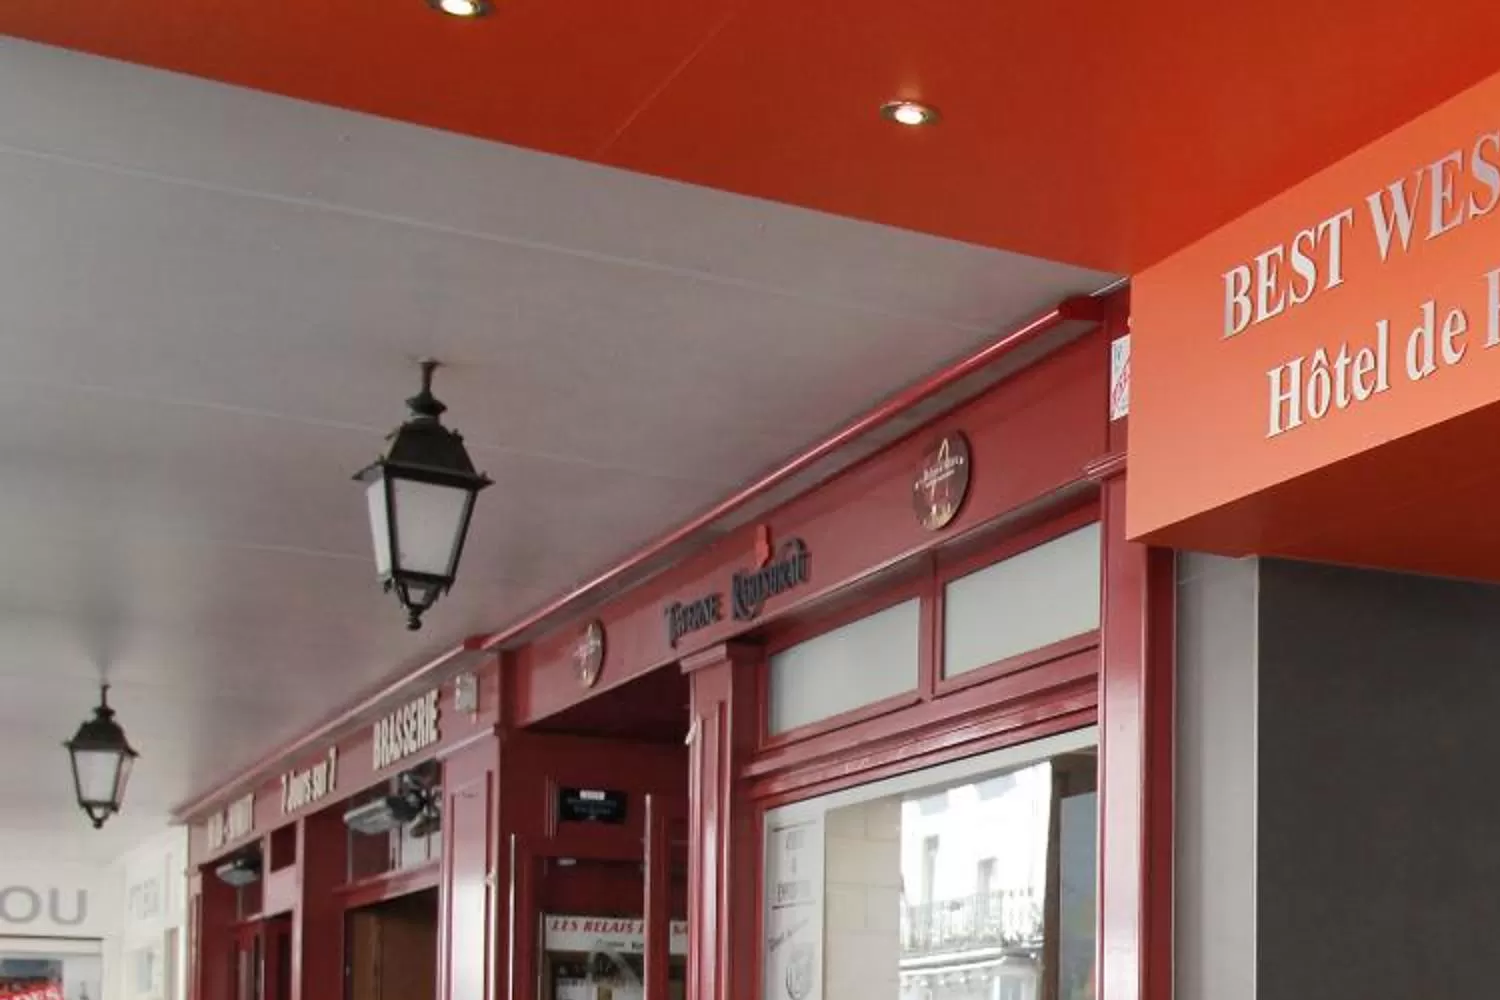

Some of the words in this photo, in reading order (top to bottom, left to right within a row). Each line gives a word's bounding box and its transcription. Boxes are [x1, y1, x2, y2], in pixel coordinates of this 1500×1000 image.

[1220, 208, 1354, 341] BEST
[1265, 320, 1391, 438] Hôtel
[1406, 300, 1469, 382] de
[373, 689, 439, 770] BRASSERIE
